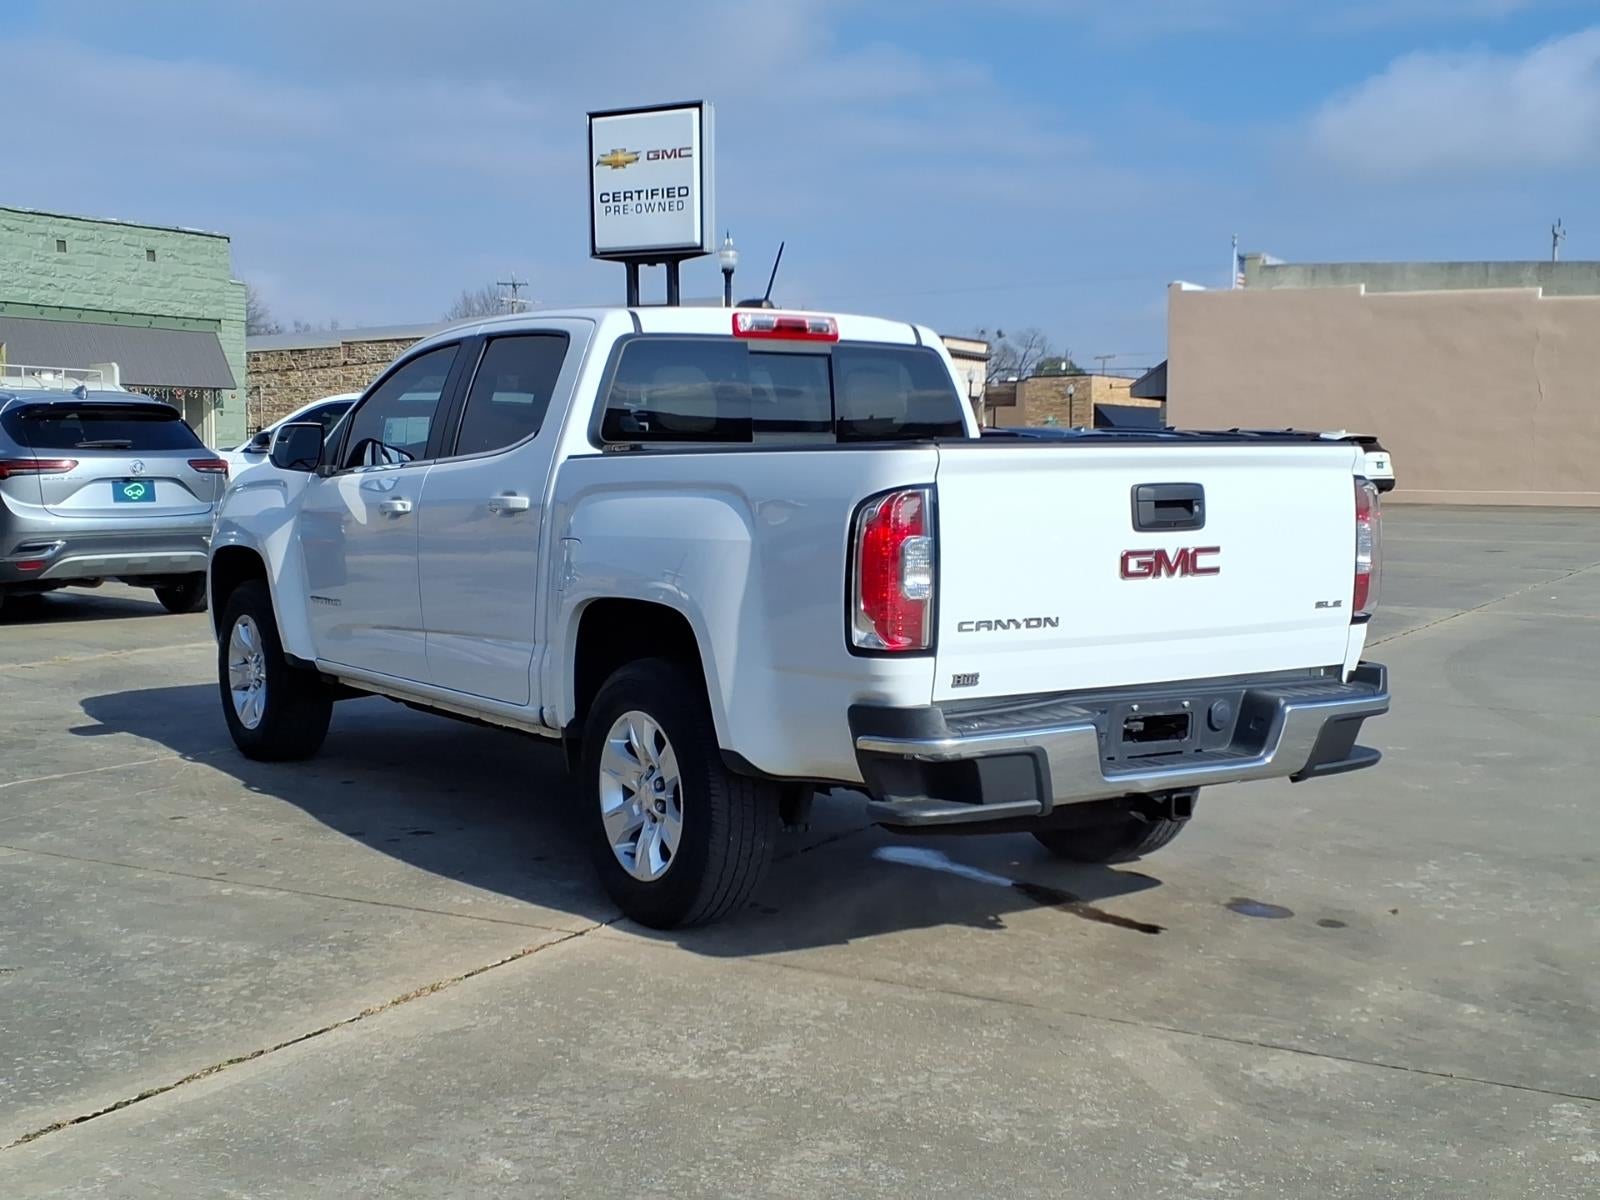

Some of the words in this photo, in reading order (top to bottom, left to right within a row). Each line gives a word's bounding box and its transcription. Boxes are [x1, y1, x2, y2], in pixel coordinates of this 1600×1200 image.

[646, 147, 692, 161] GMC
[599, 186, 690, 203] CERTIFIED
[604, 200, 685, 216] PRE-OWNED
[1120, 546, 1220, 580] GMC
[957, 616, 1059, 633] CANYON
